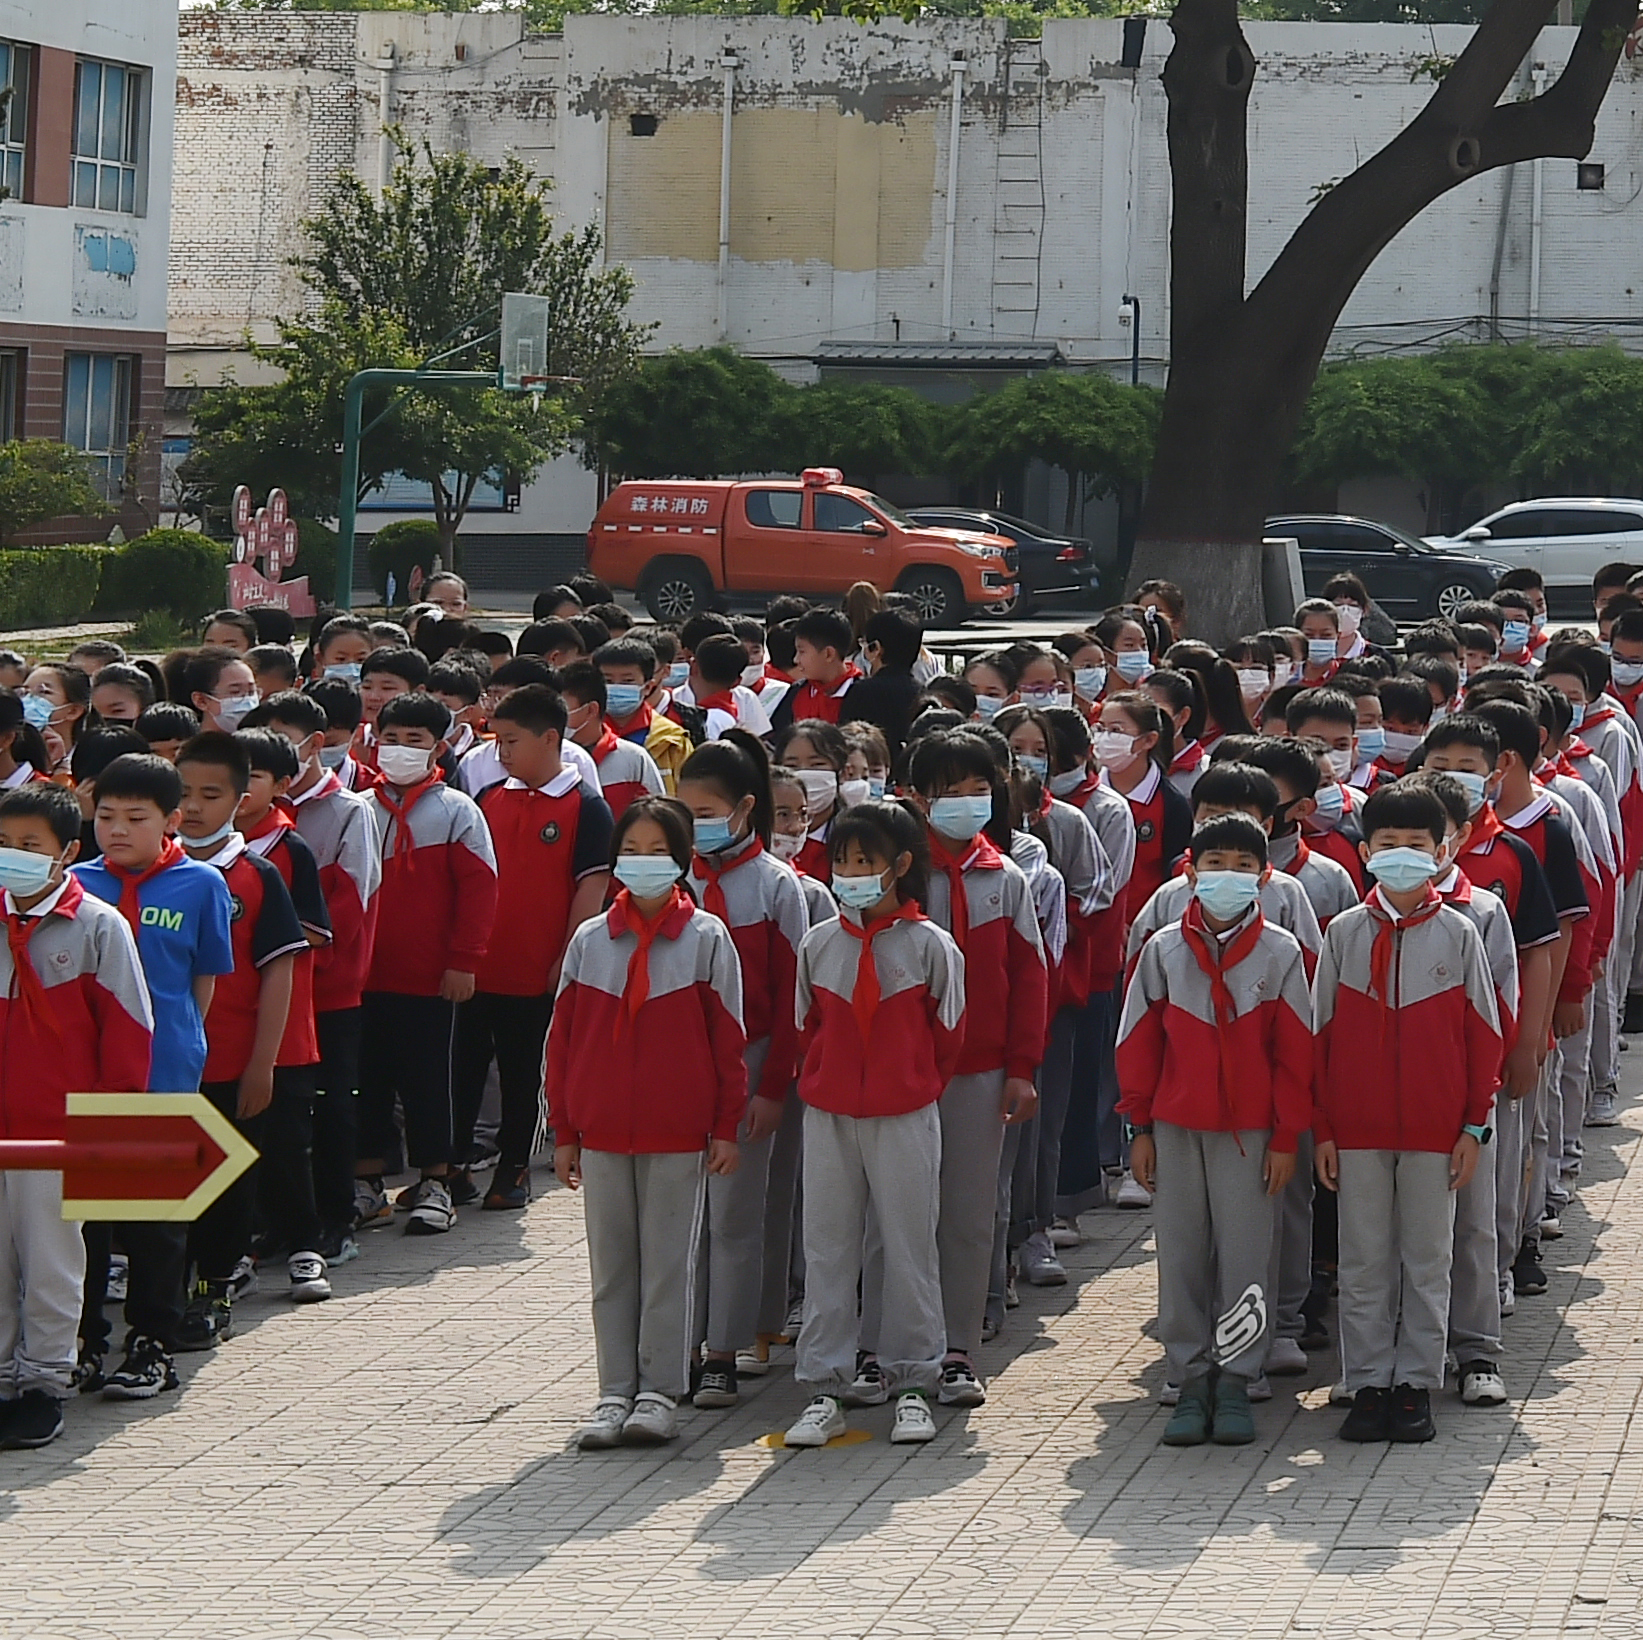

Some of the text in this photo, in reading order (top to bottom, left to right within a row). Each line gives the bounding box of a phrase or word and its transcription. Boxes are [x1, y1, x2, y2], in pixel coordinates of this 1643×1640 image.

[630, 496, 709, 514] 森林消防
[140, 906, 184, 932] OM
